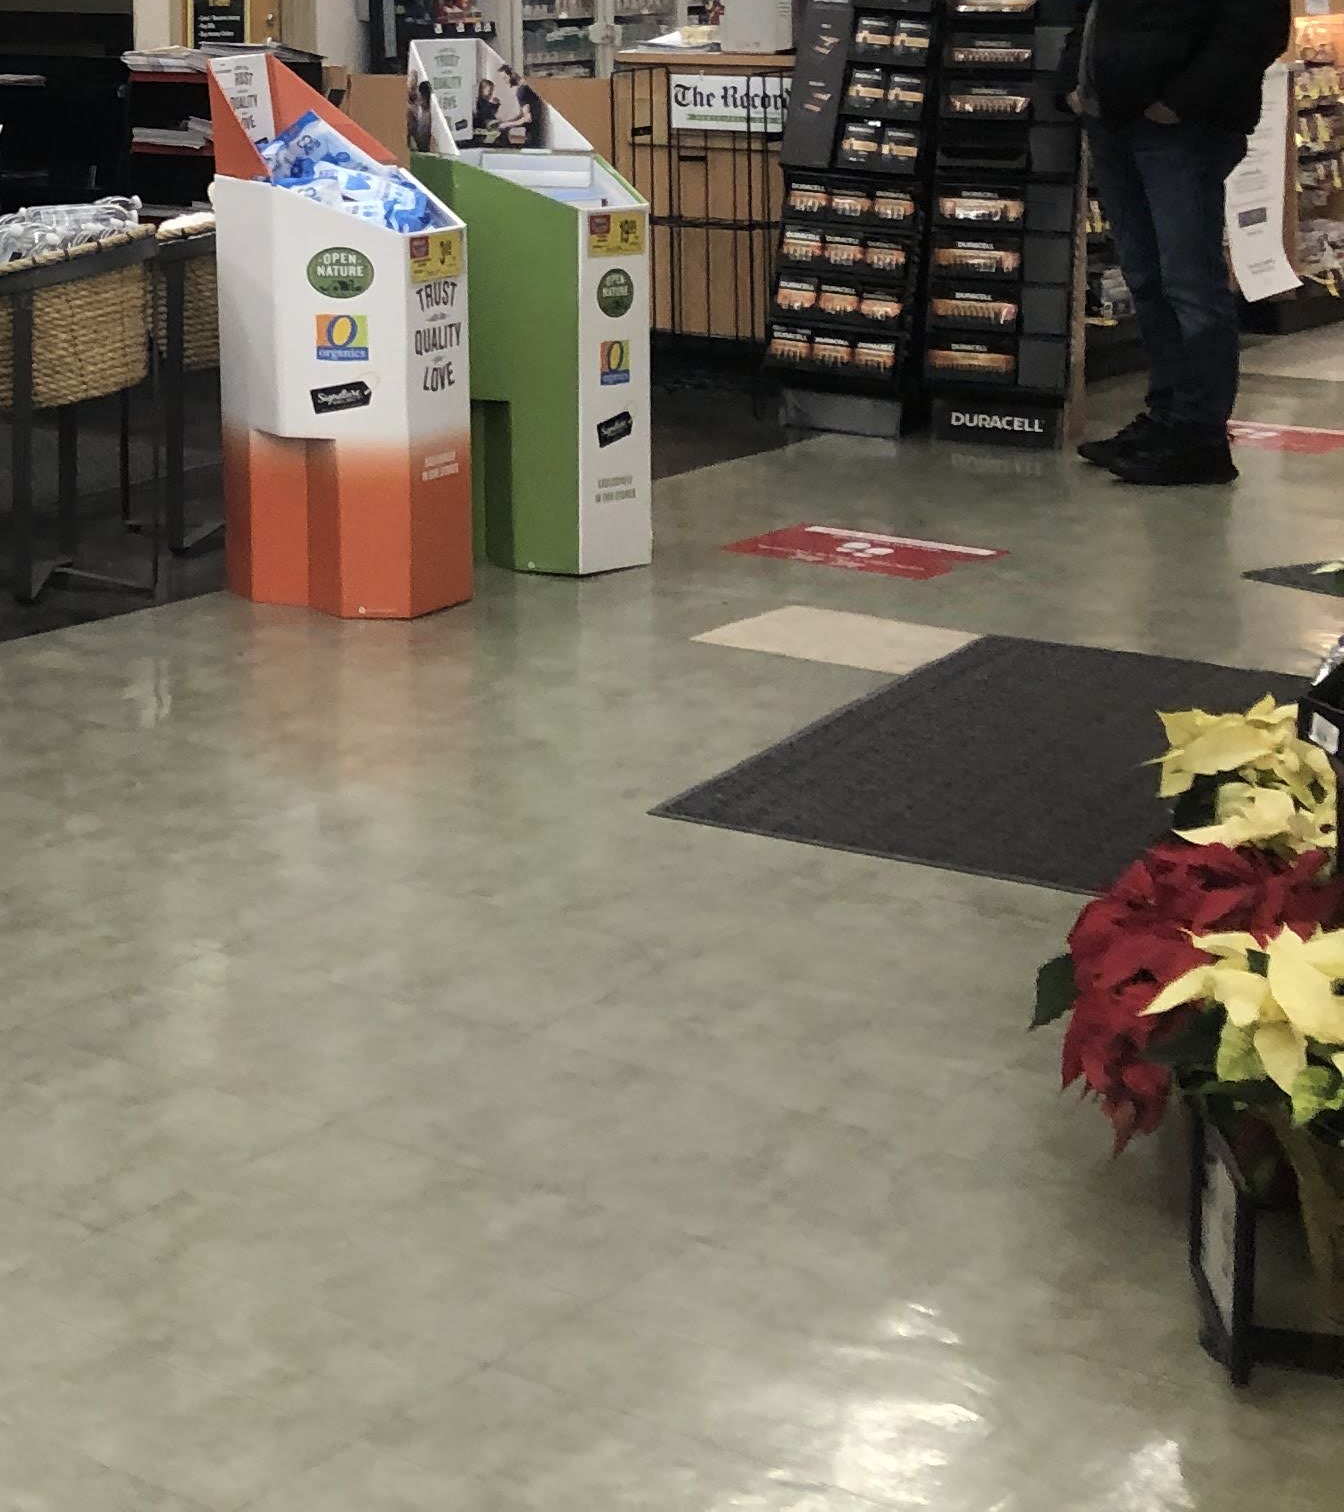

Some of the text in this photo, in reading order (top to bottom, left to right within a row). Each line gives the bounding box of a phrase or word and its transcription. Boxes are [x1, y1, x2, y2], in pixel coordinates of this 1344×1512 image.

[674, 83, 716, 108] The
[323, 253, 357, 263] OPEN
[317, 265, 365, 277] NATURE
[416, 280, 458, 312] TRUST
[415, 322, 461, 355] QUALITY
[318, 347, 367, 360] organics
[423, 361, 456, 392] LOVE
[951, 411, 1045, 433] DURACELL
